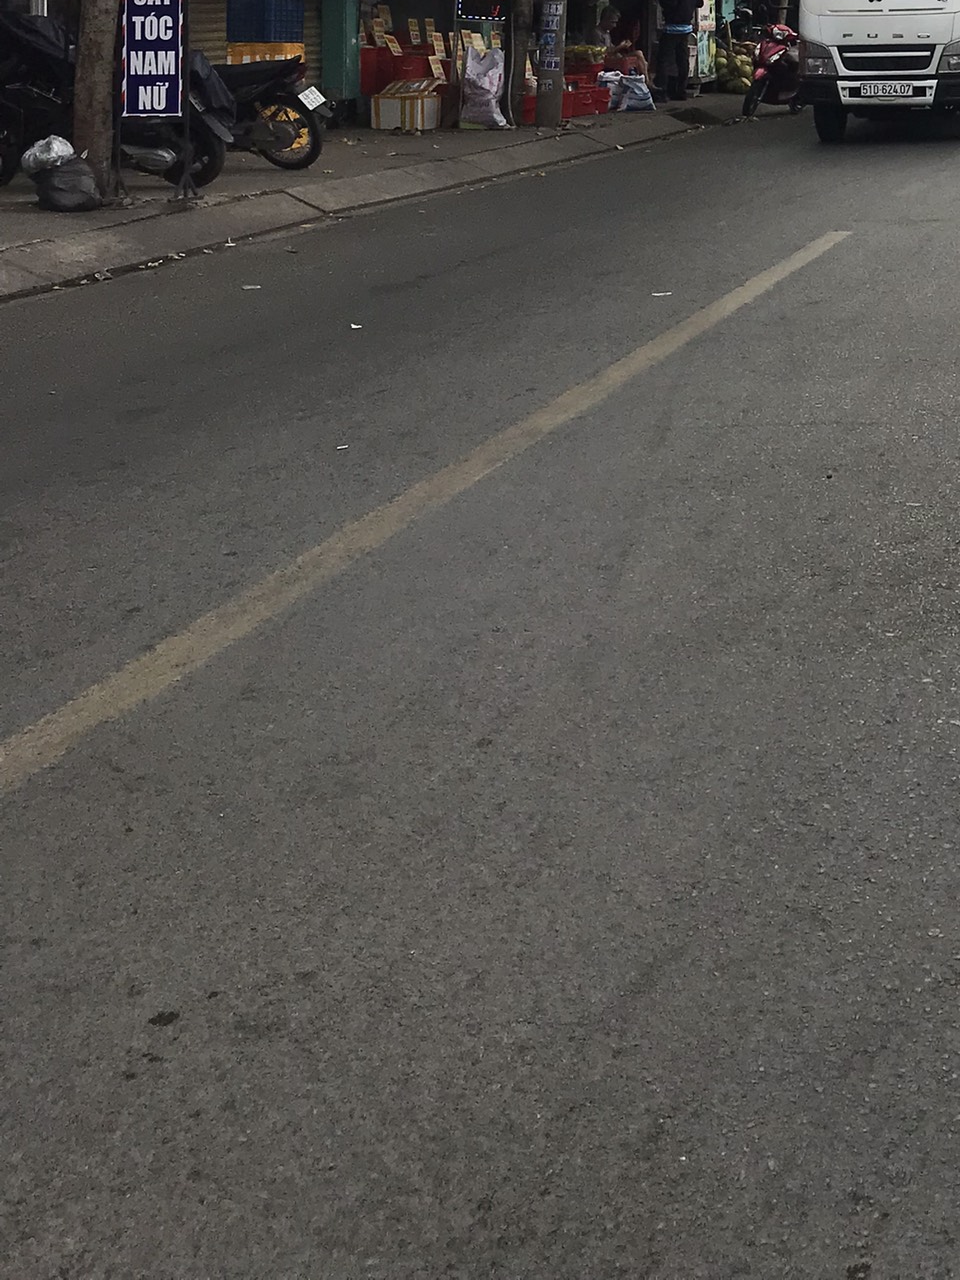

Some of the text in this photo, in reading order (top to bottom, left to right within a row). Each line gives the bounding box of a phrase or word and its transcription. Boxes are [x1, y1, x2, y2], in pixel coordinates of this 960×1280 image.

[132, 12, 173, 40] TÓC
[130, 51, 175, 75] NAM
[138, 82, 169, 110] NỮ
